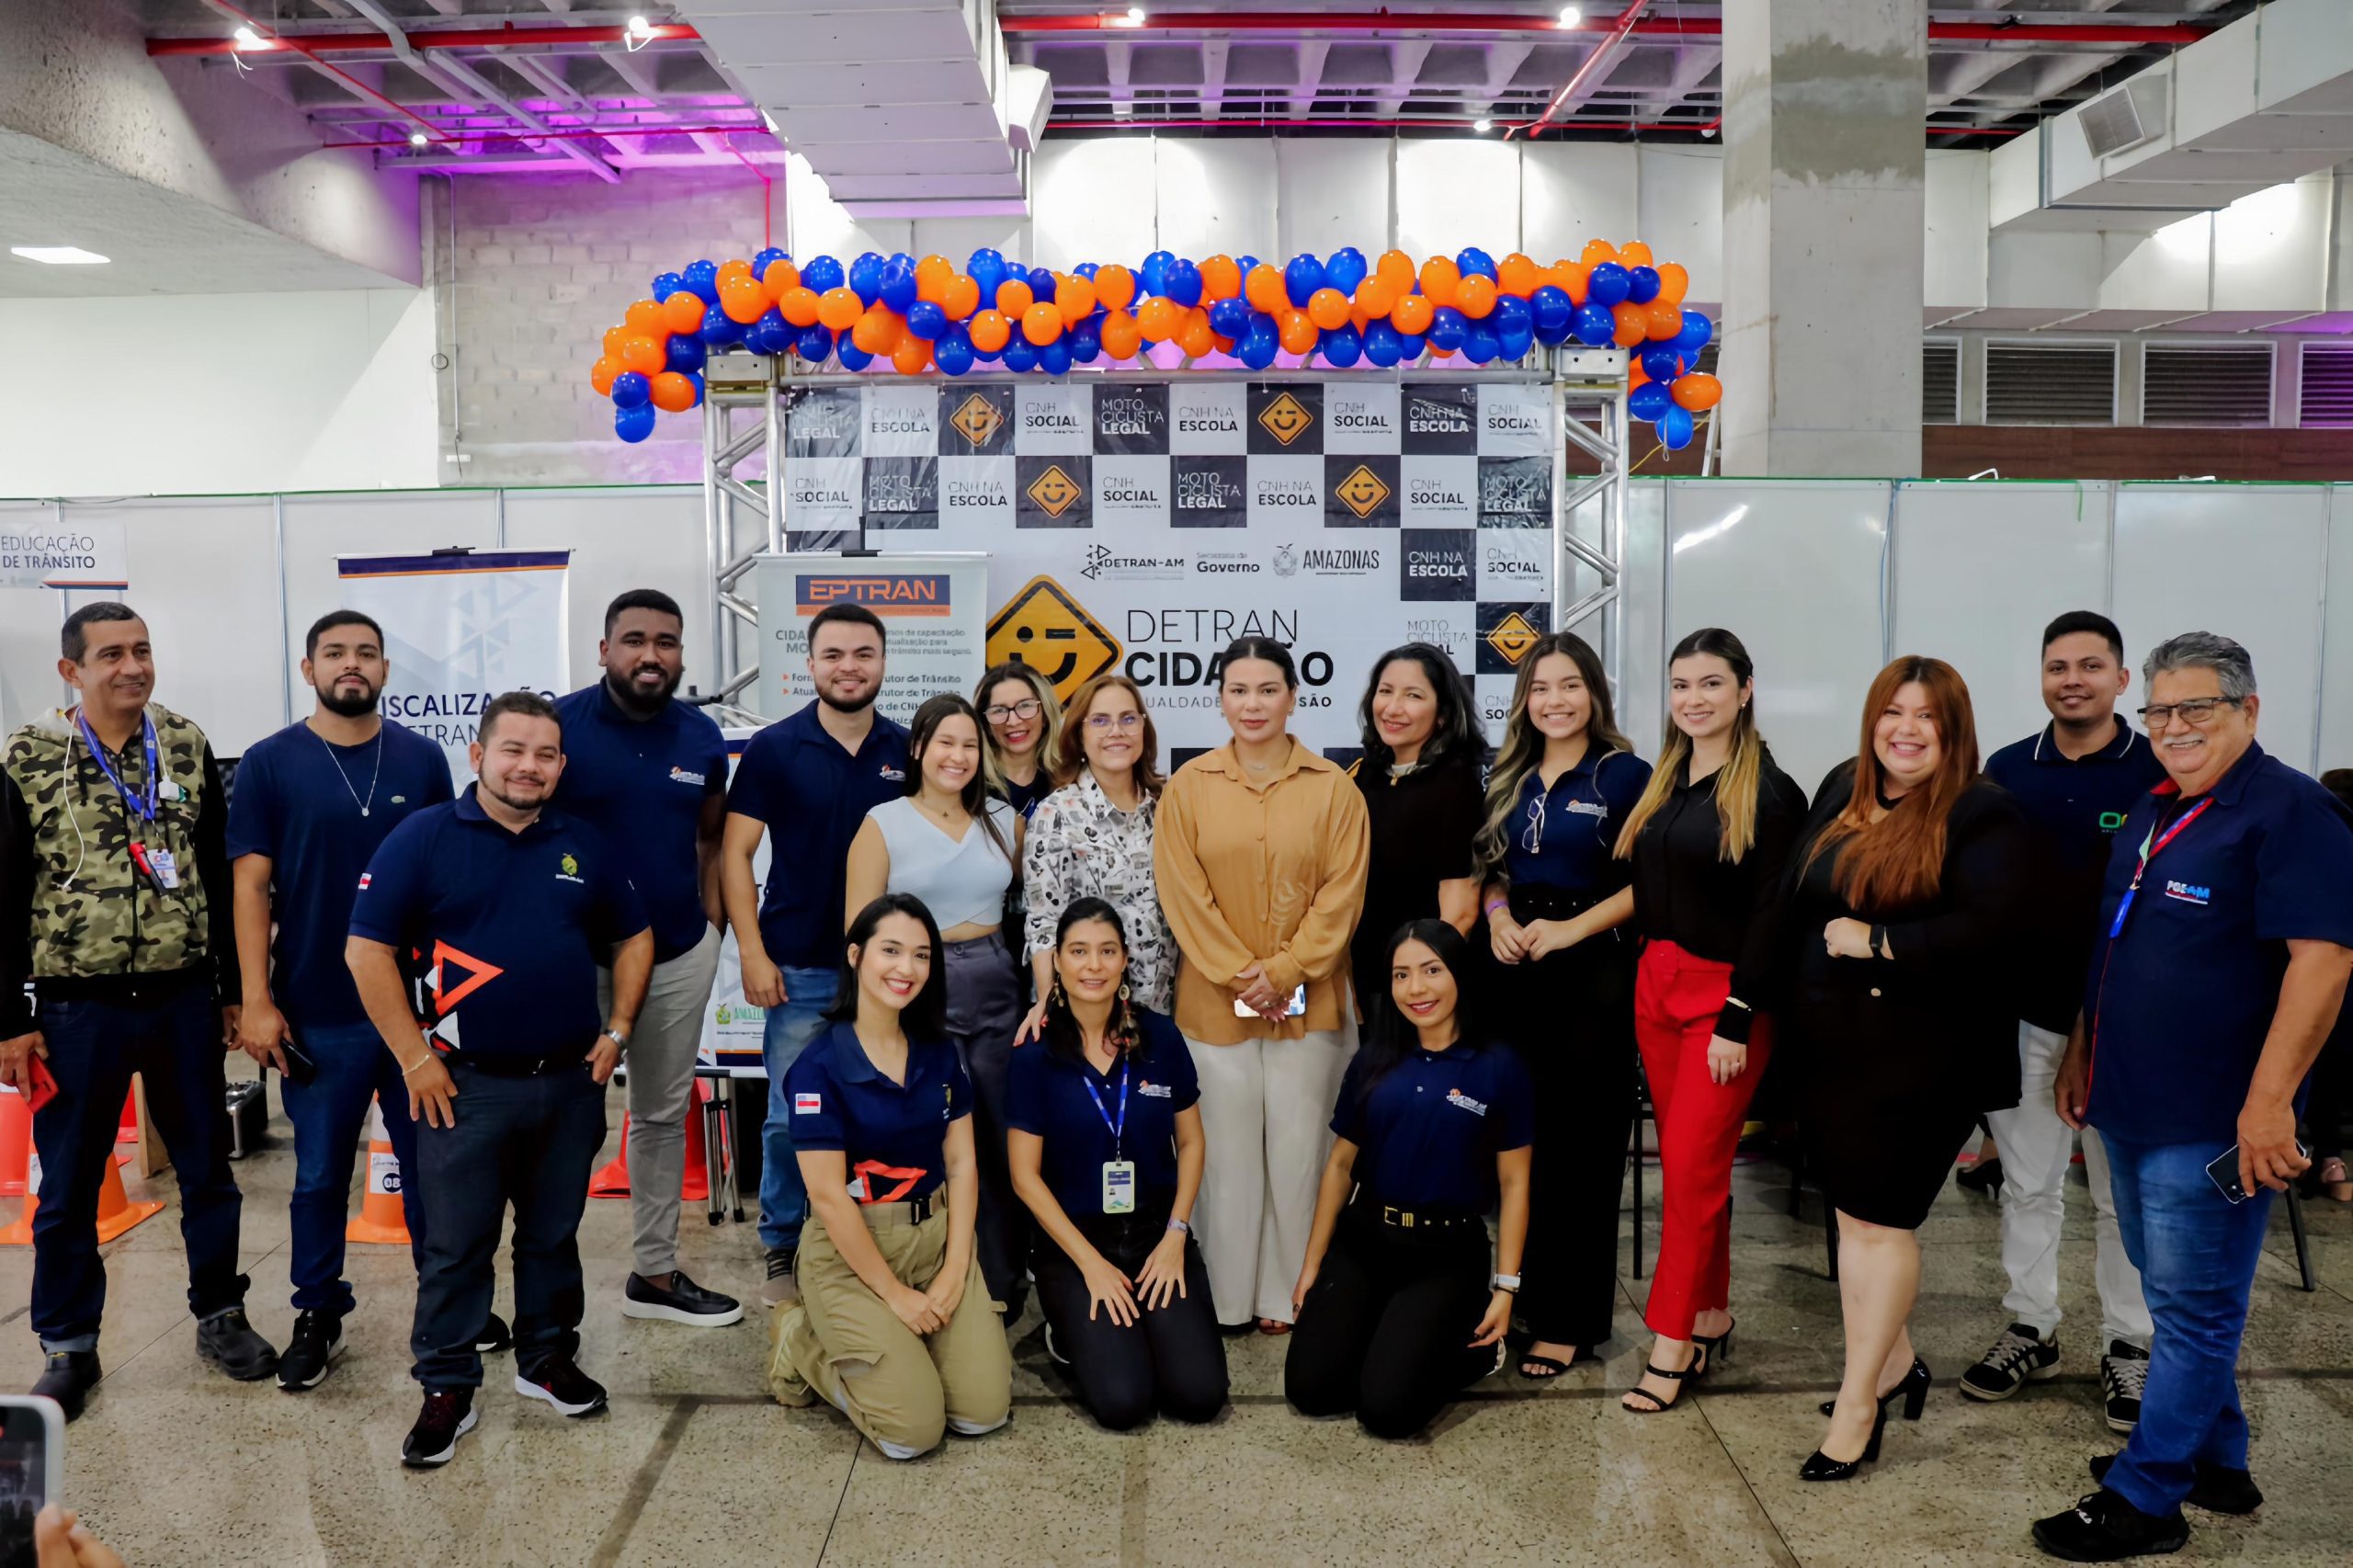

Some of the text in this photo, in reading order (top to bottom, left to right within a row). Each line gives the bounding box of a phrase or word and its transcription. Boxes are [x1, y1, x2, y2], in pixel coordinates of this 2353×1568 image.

[1025, 403, 1056, 414] CNH
[1102, 398, 1145, 411] MOTO
[1334, 402, 1365, 414] CNH
[1488, 403, 1519, 415] CNH
[1101, 411, 1165, 424] CICLISTA
[1178, 406, 1234, 418] CNH NA
[1409, 406, 1440, 419] CNH
[1026, 415, 1080, 426] SOCIAL
[1179, 420, 1238, 432] ESCOLA
[1335, 415, 1388, 426] SOCIAL
[1409, 420, 1469, 433] ESCOLA
[1488, 417, 1542, 429] SOCIAL
[793, 427, 840, 439] LEGAL
[871, 422, 930, 433] ESCOLA
[1102, 423, 1151, 435] LEGAL
[795, 477, 825, 488] CNH
[1103, 477, 1134, 488] CNH
[1177, 472, 1220, 484] MOTO
[949, 481, 1004, 493] CNH NA
[1177, 484, 1241, 497] CICLISTA
[1257, 480, 1313, 492] CNH NA
[1410, 479, 1441, 491] CNH
[795, 491, 849, 503] SOCIAL
[949, 495, 1007, 506] ESCOLA
[1103, 490, 1158, 502] SOCIAL
[1258, 494, 1316, 506] ESCOLA
[1411, 492, 1464, 504] SOCIAL
[869, 499, 919, 512] LEGAL
[1177, 496, 1226, 509] LEGAL
[1484, 500, 1532, 512] LEGAL
[1, 533, 95, 555] EDUCAÇÃO
[3, 553, 96, 569] DE TRÂNSITO
[1104, 558, 1185, 568] DETRAN-AM
[1303, 550, 1380, 570] AMAZONAS
[1409, 551, 1464, 563] CNH NA
[1197, 561, 1260, 574] Governo
[1409, 564, 1468, 577] ESCOLA
[1487, 562, 1541, 573] SOCIAL
[810, 580, 936, 600] EPTRAN
[1127, 609, 1298, 642] DETRAN
[1407, 619, 1449, 631] MOTO
[776, 630, 809, 641] CIDA
[1406, 631, 1469, 643] CICLISTA
[1125, 645, 1334, 687] CIDAO
[906, 675, 919, 683] de
[921, 675, 961, 683] Trânsito
[885, 702, 899, 710] de
[1145, 696, 1222, 708] UALDADE
